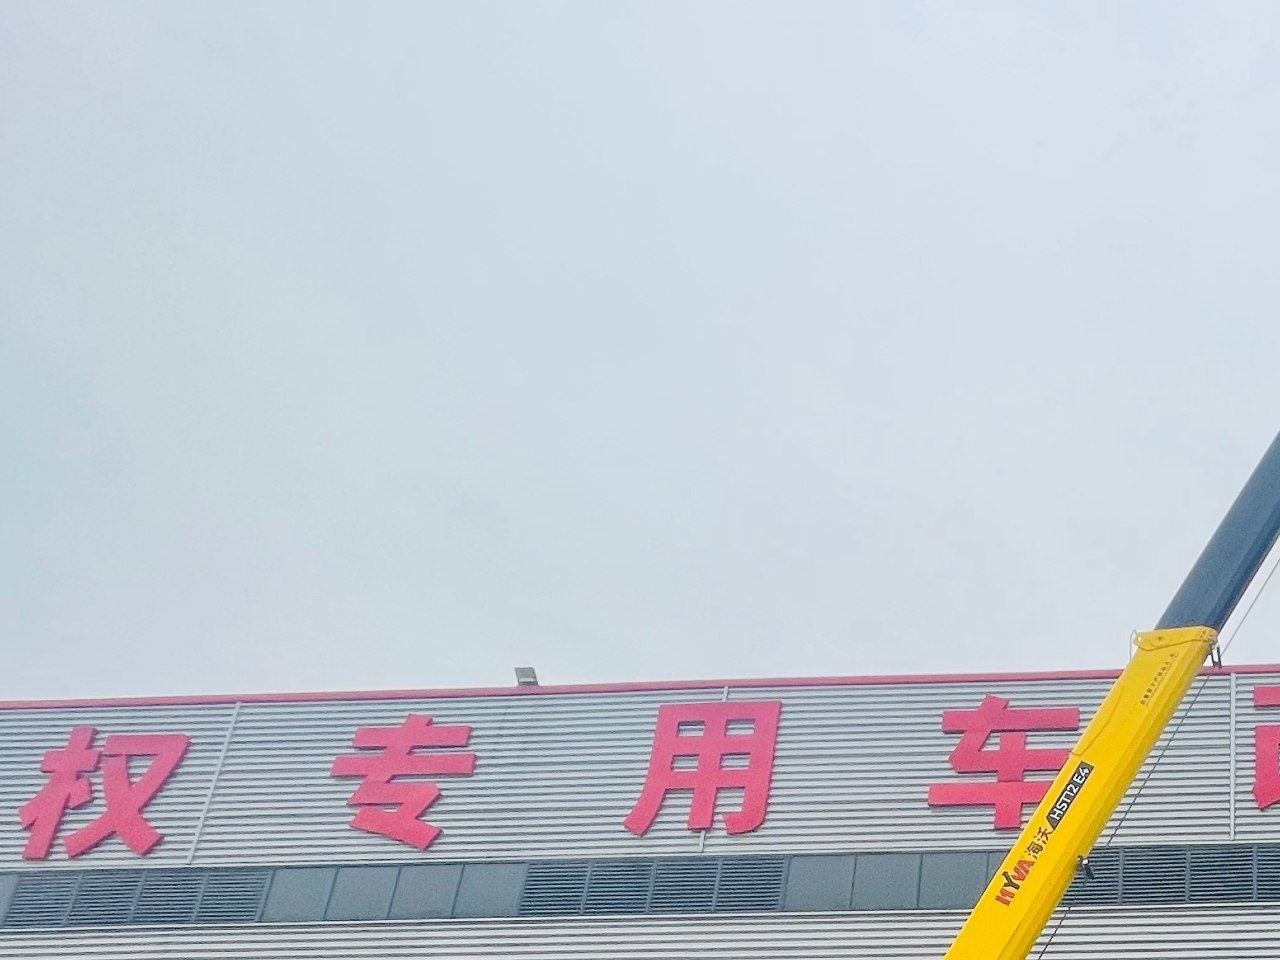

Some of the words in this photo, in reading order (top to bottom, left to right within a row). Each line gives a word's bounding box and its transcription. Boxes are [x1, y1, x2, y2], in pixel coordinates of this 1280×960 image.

[995, 859, 1035, 907] HYVA
[1024, 826, 1054, 859] 海沃
[1072, 766, 1091, 784] E4
